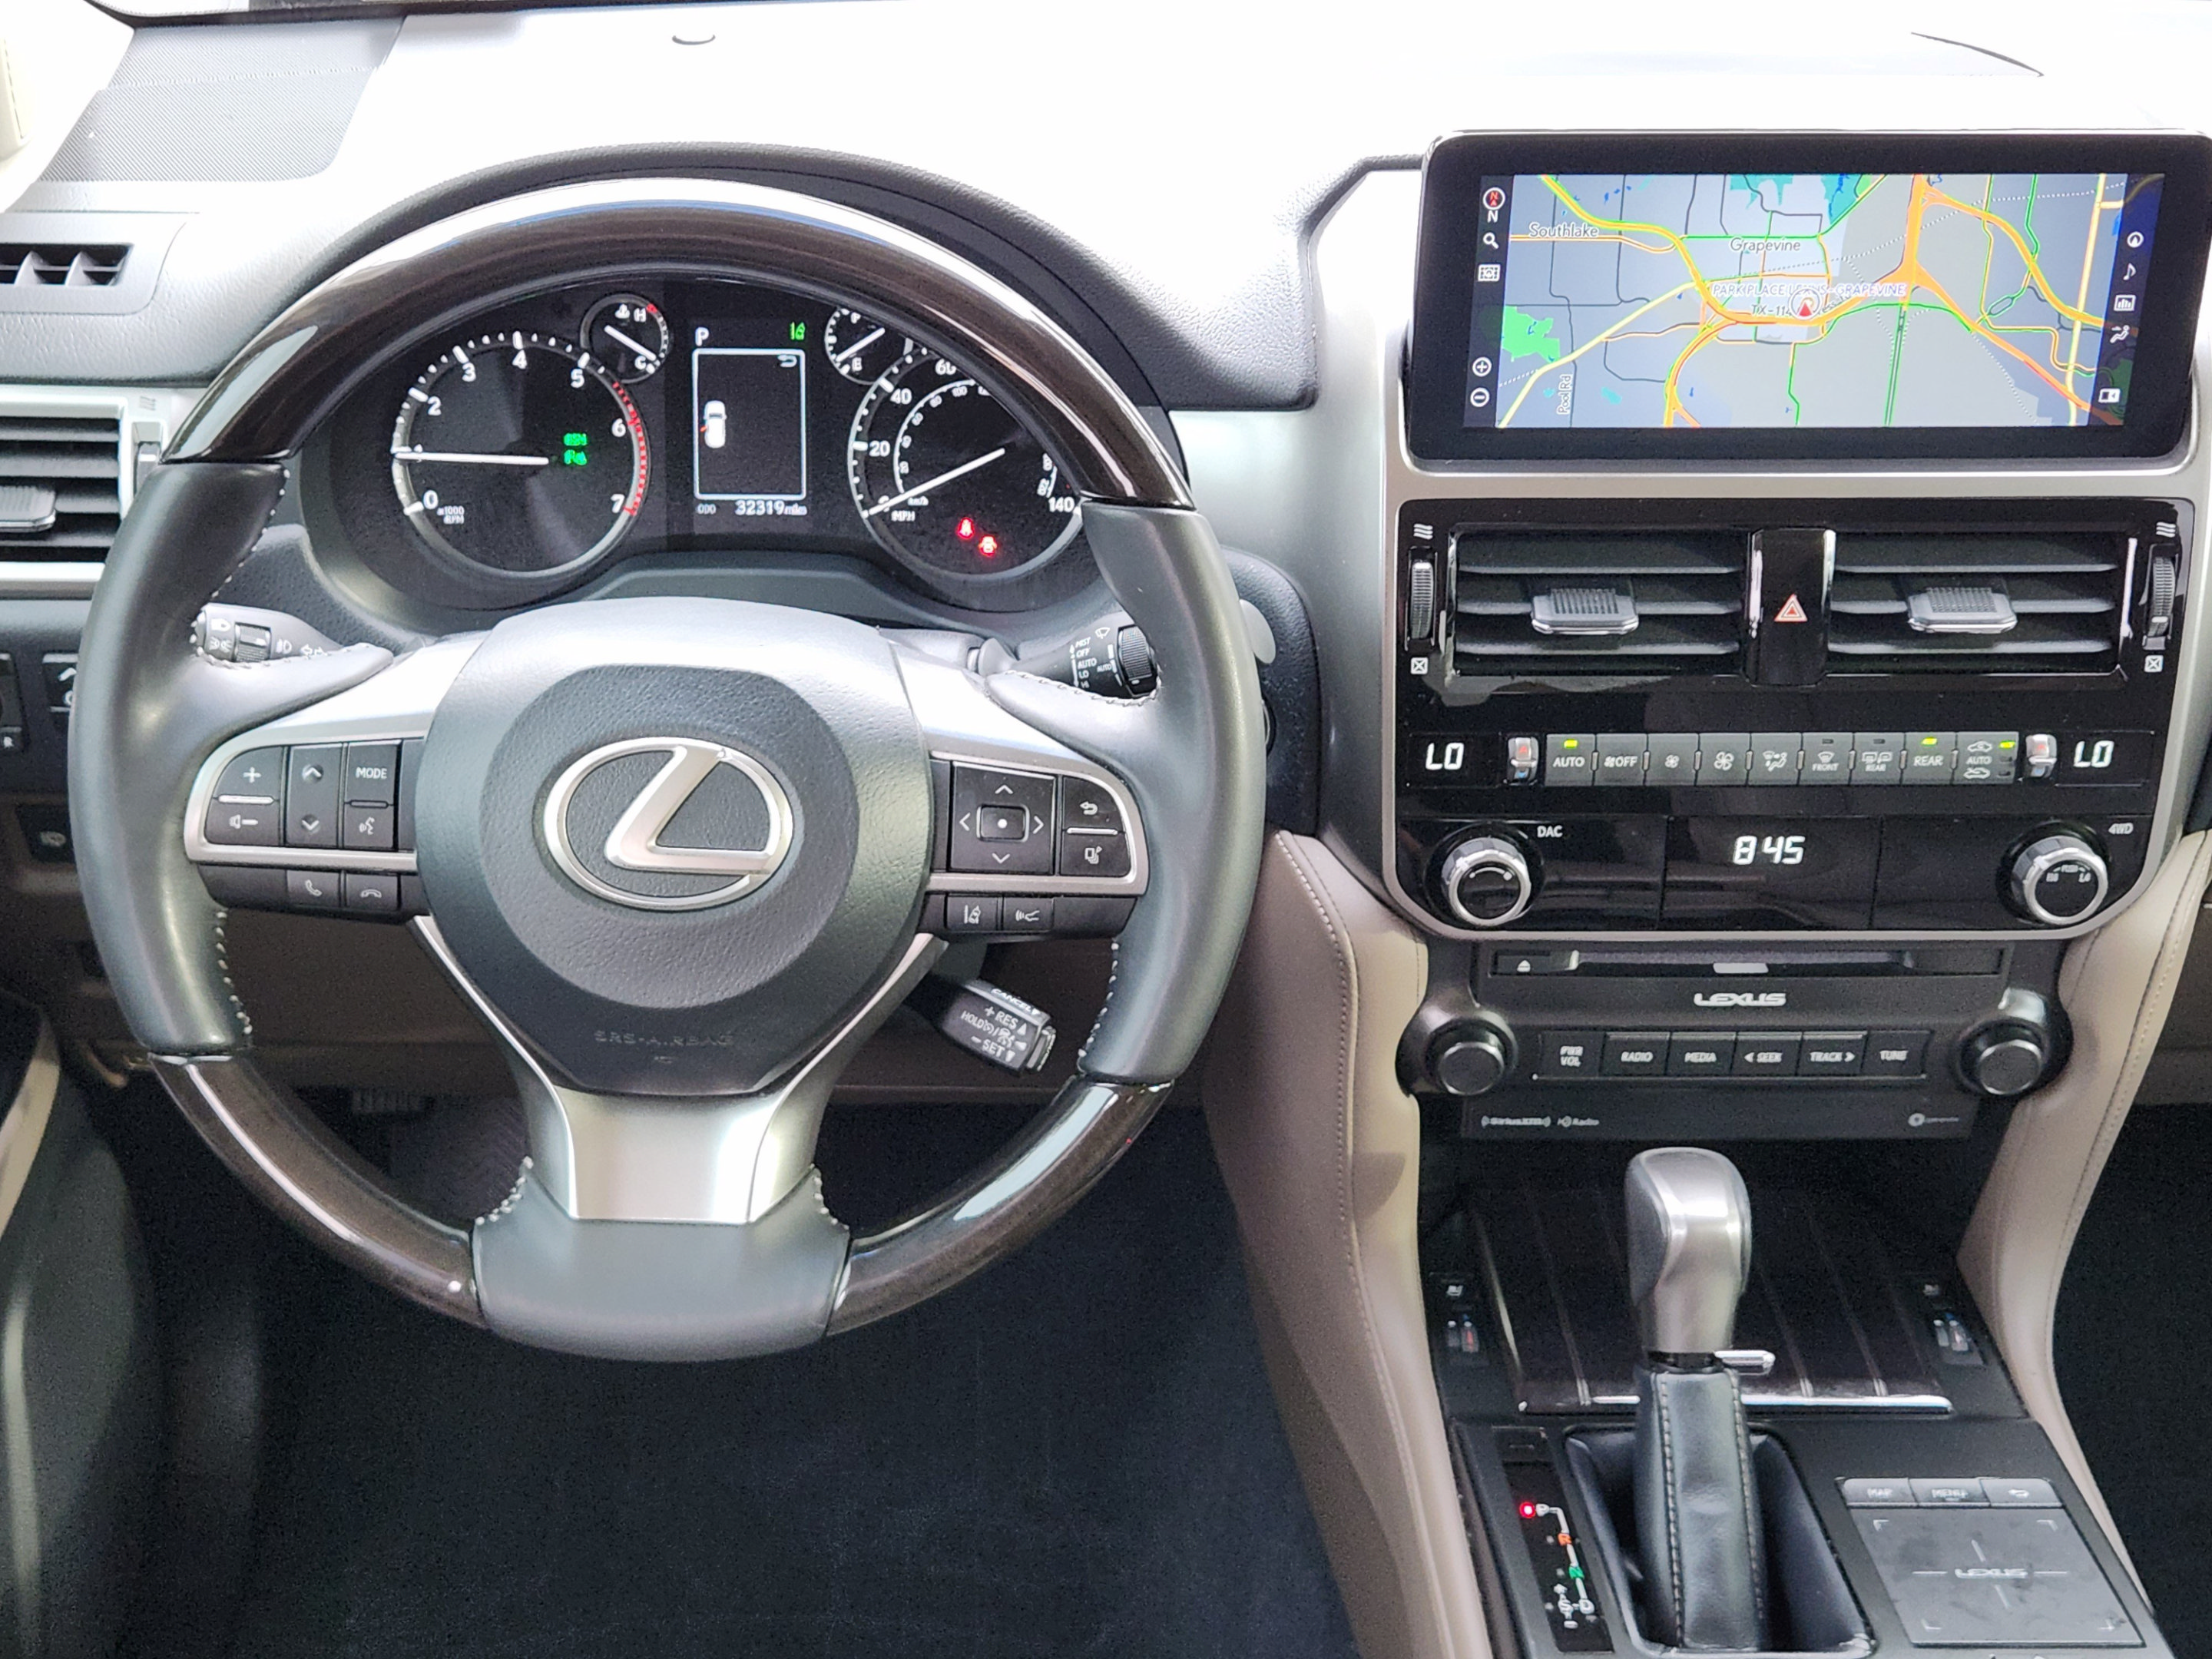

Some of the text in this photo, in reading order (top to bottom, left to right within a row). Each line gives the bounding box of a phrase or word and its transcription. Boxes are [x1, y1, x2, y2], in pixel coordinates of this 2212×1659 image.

[1487, 210, 1498, 223] N
[1528, 221, 1599, 237] Southlake
[1730, 238, 1802, 252] Grapevine
[1712, 283, 1746, 296] PARK
[1747, 283, 1786, 296] PLACE
[634, 307, 647, 323] H
[695, 326, 710, 346] P
[512, 350, 528, 369] 4
[634, 356, 647, 370] C
[852, 357, 863, 372] E
[462, 362, 476, 382] 3
[570, 369, 584, 388] 5
[890, 388, 912, 405] 40
[1557, 374, 1572, 415] Pool Rd
[427, 396, 442, 416] 2
[611, 419, 626, 437] 6
[869, 440, 891, 457] 20
[423, 489, 439, 510] 0
[610, 493, 626, 513] 7
[1048, 496, 1075, 513] 140
[697, 503, 717, 515] ODO
[735, 499, 785, 515] 32319
[443, 515, 465, 525] RPM
[892, 510, 916, 522] MPH
[1076, 647, 1091, 659] OFF
[1078, 657, 1098, 670] AUTO
[1097, 663, 1112, 673] AUTO
[1078, 670, 1090, 680] LO
[1426, 742, 1465, 770] LO
[1914, 755, 1944, 767] REAR
[1966, 756, 1992, 765] AUTO
[2075, 740, 2114, 768] LO
[1553, 757, 1585, 768] AUTO
[1615, 756, 1638, 768] OFF
[1813, 763, 1839, 772] FRONT
[1866, 763, 1887, 772] REAR
[356, 767, 388, 780] MODE
[1537, 824, 1563, 838] DAC
[2108, 823, 2134, 835] 4WD
[991, 988, 1031, 1012] CANCEL
[1694, 992, 1787, 1007] LEXUS
[960, 1010, 985, 1028] HOLD
[995, 1011, 1019, 1031] RES
[982, 1038, 1006, 1058] SET
[1879, 1049, 1909, 1061] TUNE
[1560, 1055, 1581, 1067] VOL
[1621, 1051, 1654, 1063] RADIO
[1684, 1051, 1717, 1063] MEDIA
[1757, 1051, 1784, 1063] SEEK
[1810, 1051, 1844, 1063] TRACK
